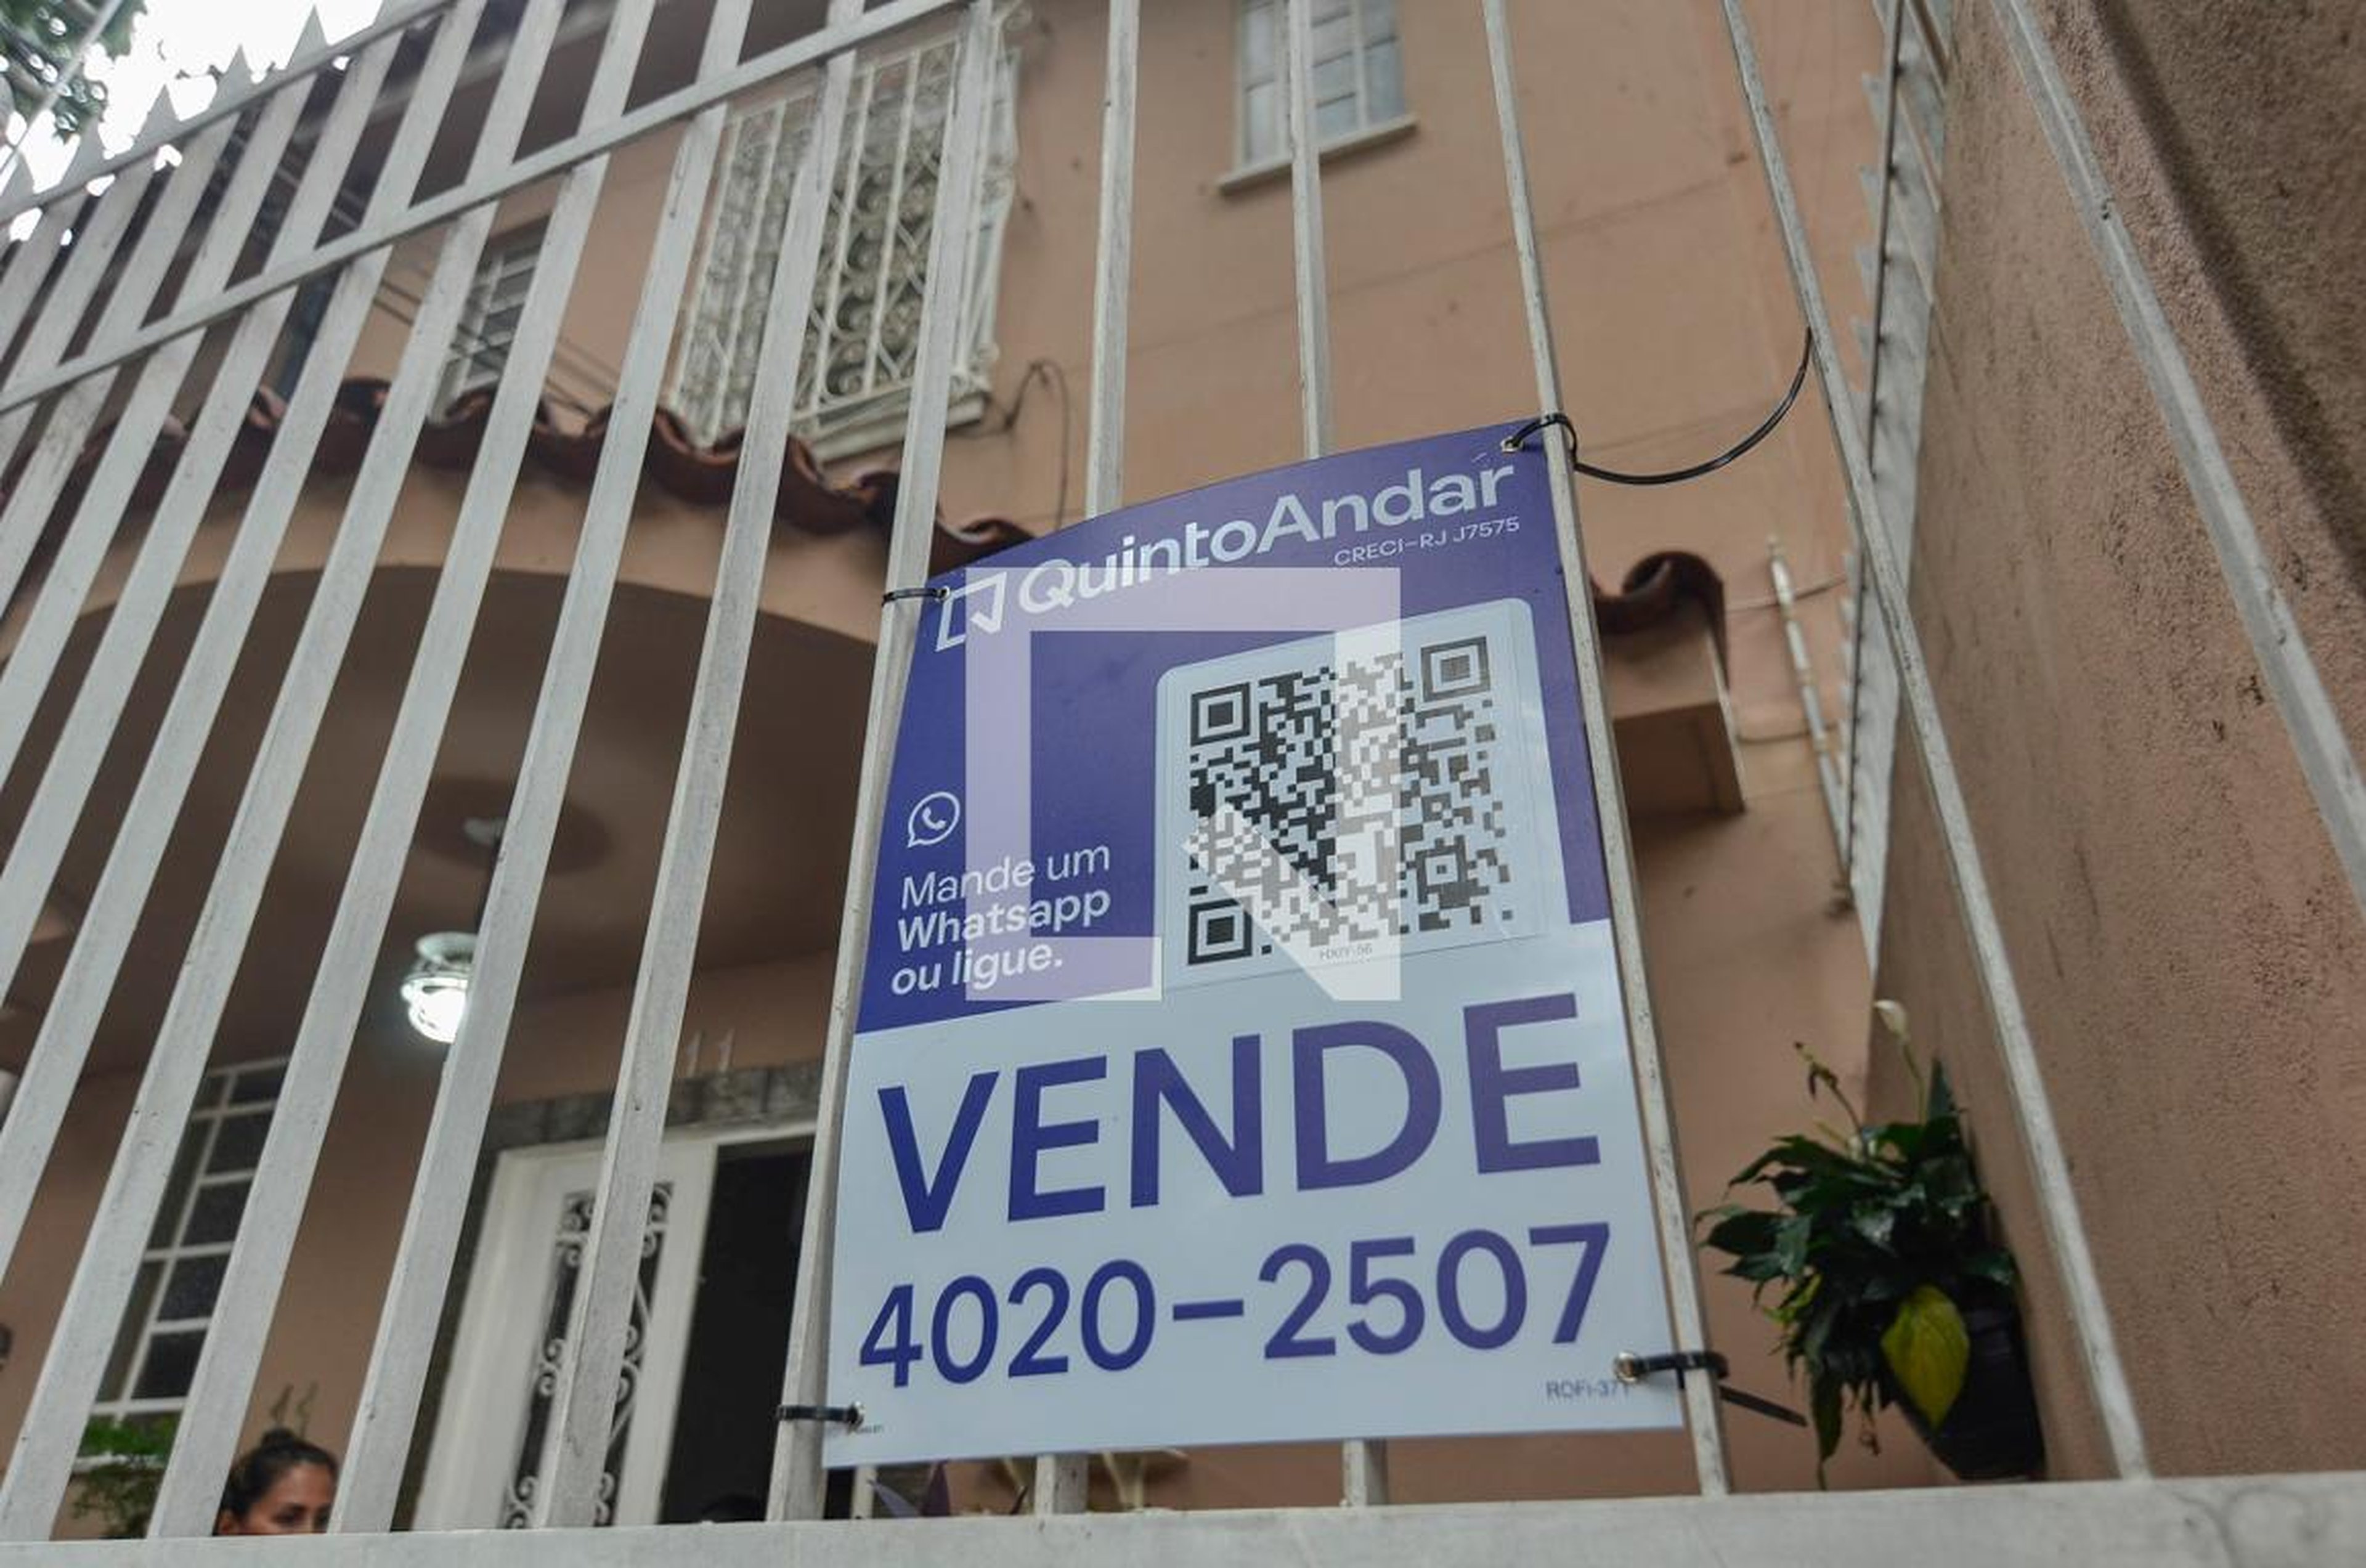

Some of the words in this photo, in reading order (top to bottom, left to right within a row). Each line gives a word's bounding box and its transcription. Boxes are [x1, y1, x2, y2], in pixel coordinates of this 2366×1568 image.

[1018, 463, 1514, 613] QuintoAndar
[1333, 530, 1447, 566] CRECI-RJ
[1452, 516, 1520, 542] J7575
[901, 855, 1035, 910] Mande
[1048, 845, 1110, 882] um
[898, 889, 1110, 953] Whatsapp
[891, 962, 941, 996] ou
[952, 943, 1063, 991] ligue.
[876, 993, 1601, 1233] VENDE
[859, 1222, 1610, 1388] 4020-2507
